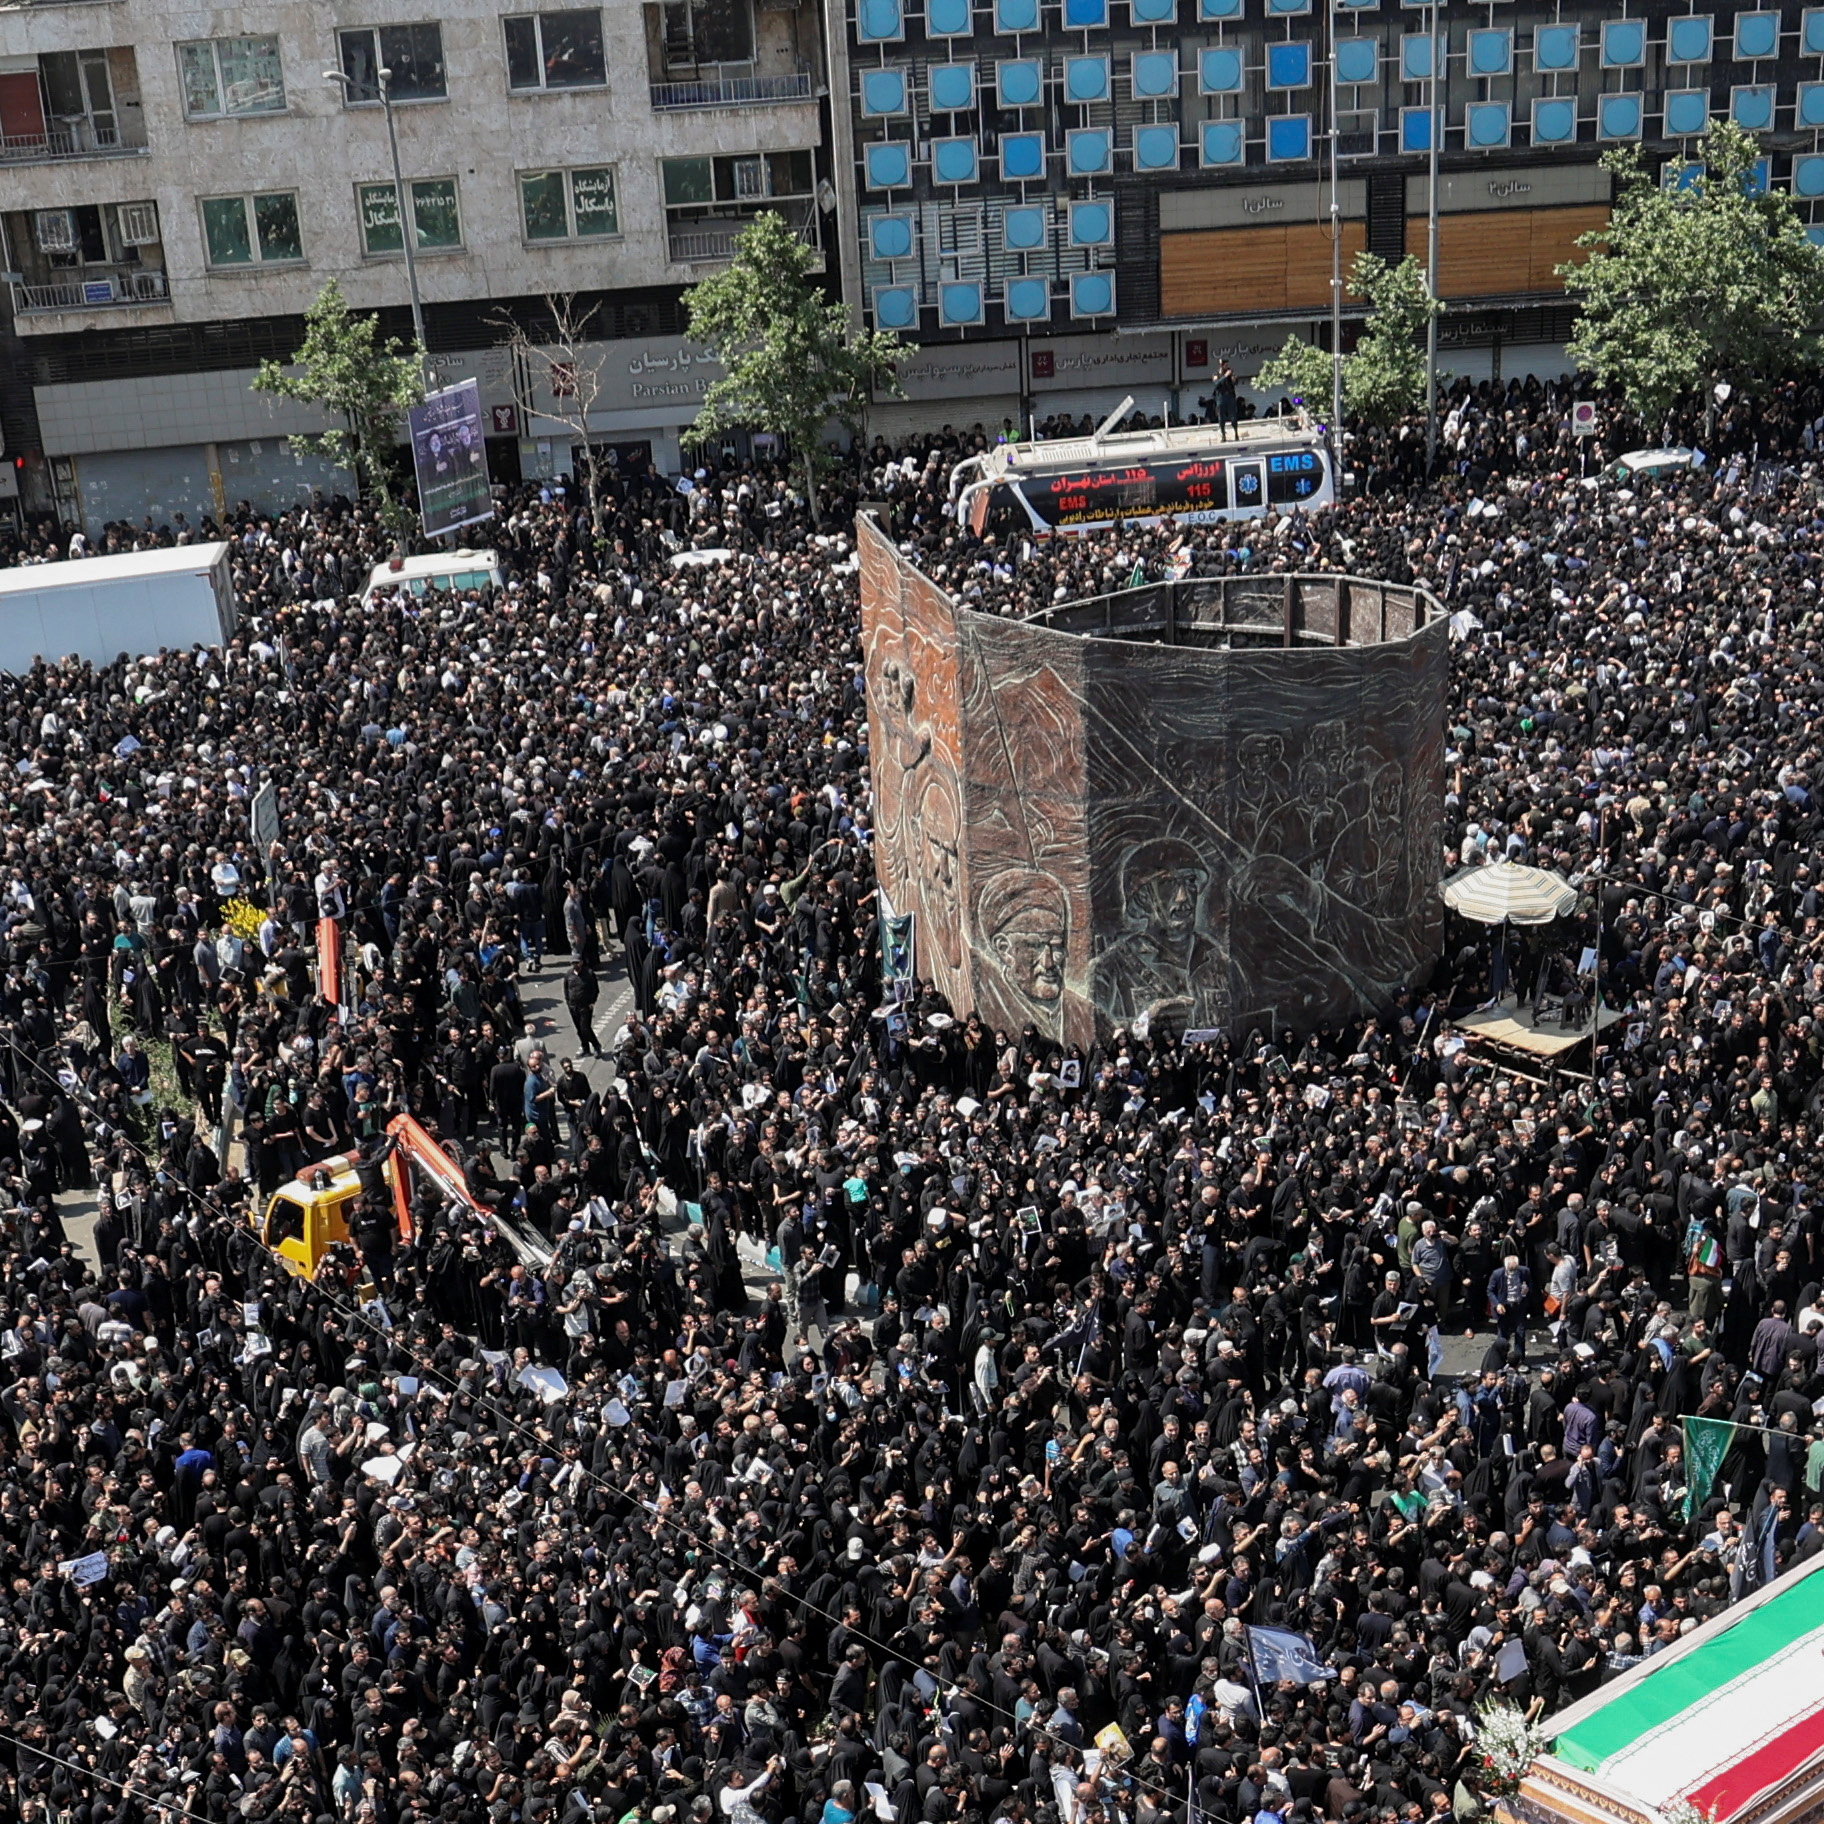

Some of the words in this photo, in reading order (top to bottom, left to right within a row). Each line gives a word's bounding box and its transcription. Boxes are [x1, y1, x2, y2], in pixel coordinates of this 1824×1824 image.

[575, 194, 614, 215] پاسکال
[628, 350, 692, 376] پارسیان
[631, 382, 690, 398] Parsian
[1176, 460, 1222, 481] اورژانس
[1270, 453, 1314, 473] EMS
[1050, 472, 1091, 493] تهران
[1186, 482, 1211, 498] 115
[1058, 496, 1087, 511] EMS
[1188, 510, 1216, 524] E.O.C
